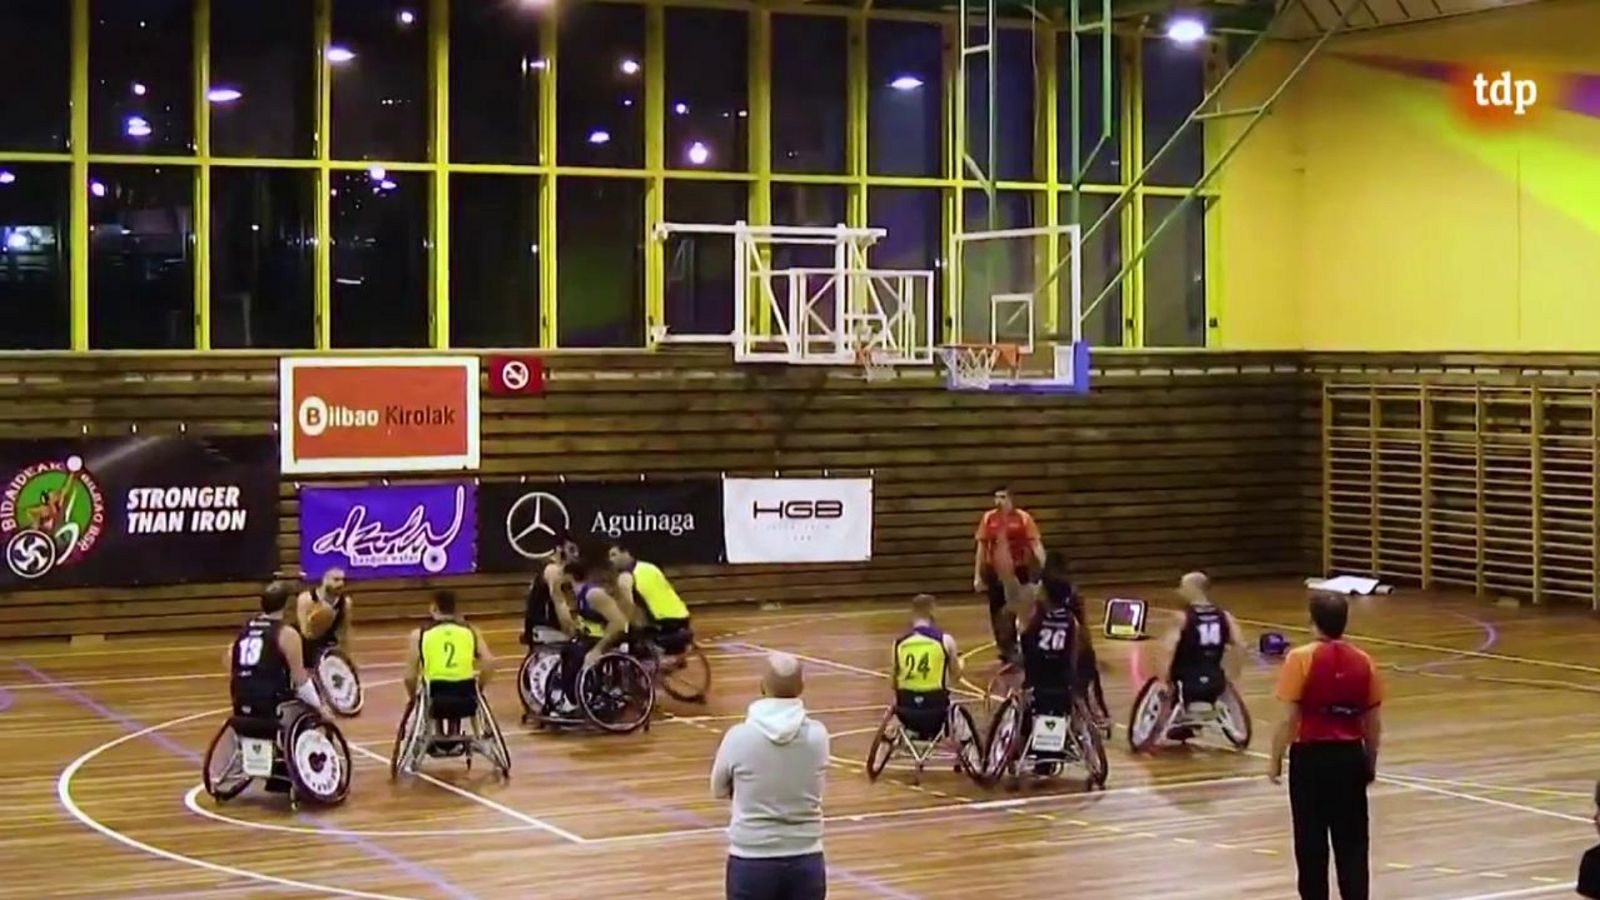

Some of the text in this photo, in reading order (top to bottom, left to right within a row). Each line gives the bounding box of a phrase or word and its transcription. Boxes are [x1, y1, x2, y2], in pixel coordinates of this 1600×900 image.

[299, 396, 456, 436] Bilbao Kirolak
[126, 486, 240, 510] STRONGER
[753, 500, 843, 519] HGB
[127, 509, 247, 534] THAN IRON
[591, 509, 695, 539] Aguinaga
[443, 641, 458, 669] 2
[904, 651, 931, 681] 24
